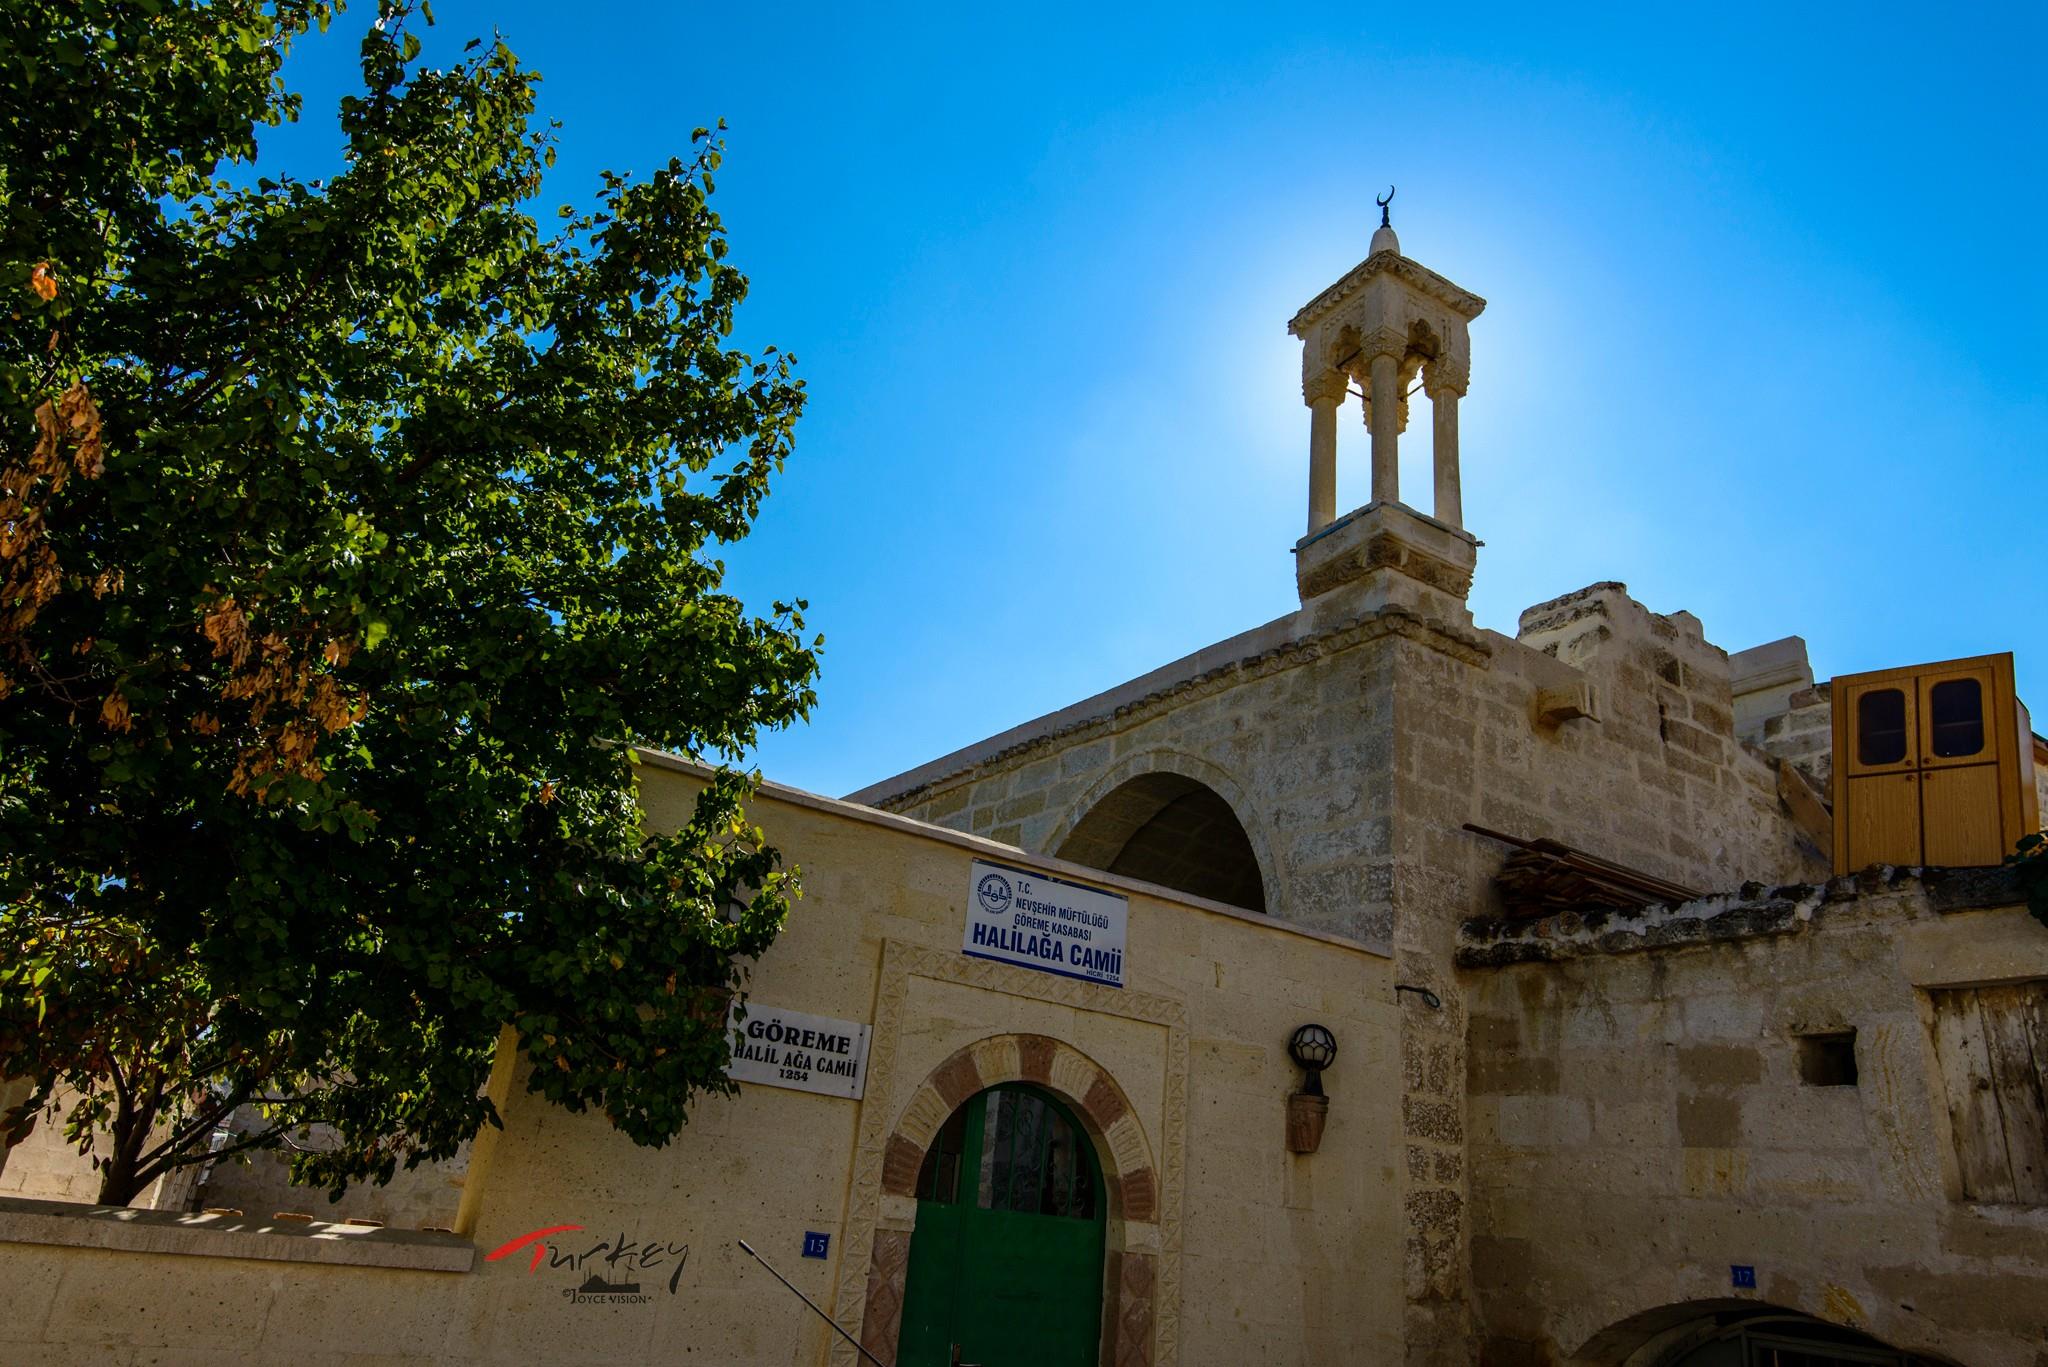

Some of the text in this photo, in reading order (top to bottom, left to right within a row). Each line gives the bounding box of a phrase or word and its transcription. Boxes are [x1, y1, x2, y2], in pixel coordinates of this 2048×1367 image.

[1017, 881, 1032, 895] T.C.
[1014, 913, 1092, 942] GÖREME KASABASI
[1015, 898, 1056, 918] NEVŞEHİR
[1058, 907, 1109, 929] MÜFTÜLÜĞÜ
[972, 922, 1122, 975] HALİLAĞA CAMİİ
[747, 1018, 851, 1055] GÖREME
[733, 1043, 858, 1078] HALİL AĞA CAMİİ
[779, 1068, 809, 1082] 1254
[810, 1239, 825, 1253] 15
[1738, 1270, 1750, 1282] 17
